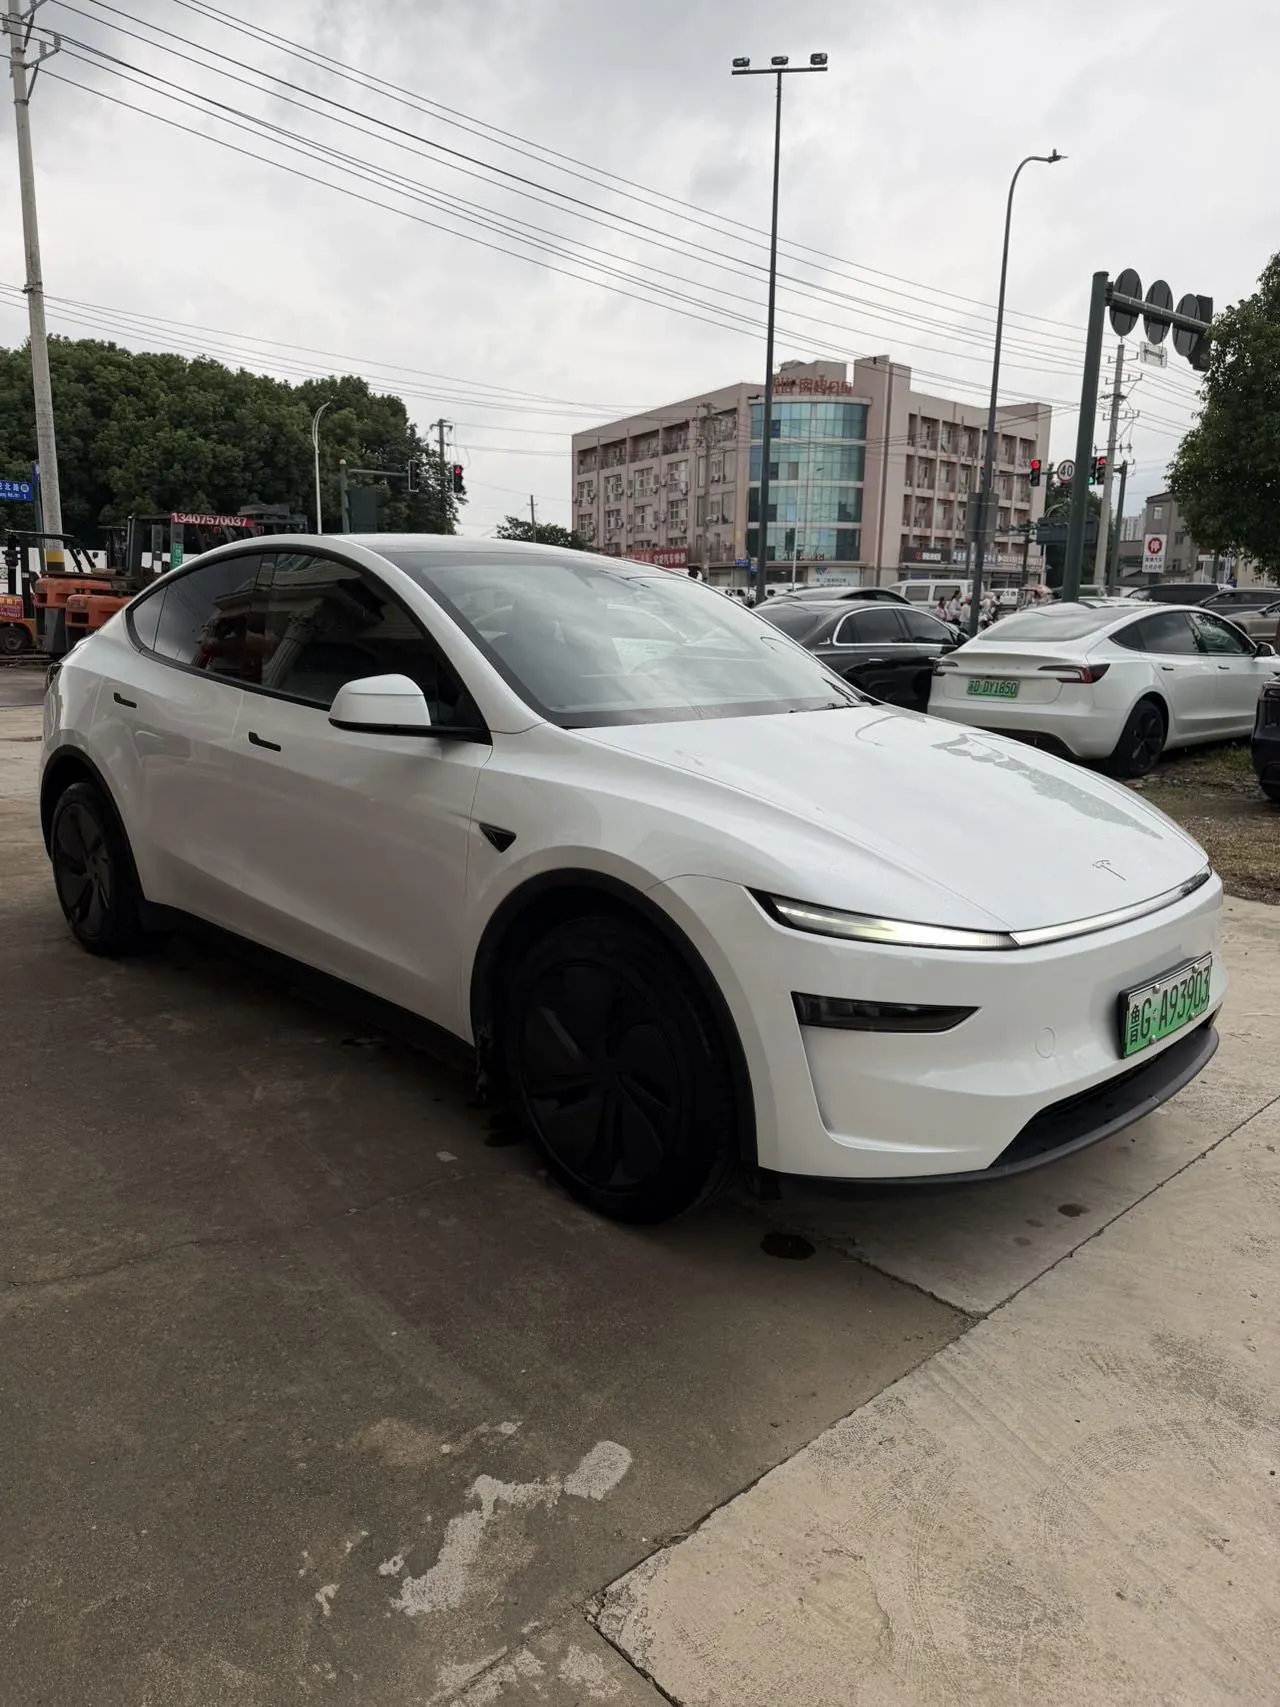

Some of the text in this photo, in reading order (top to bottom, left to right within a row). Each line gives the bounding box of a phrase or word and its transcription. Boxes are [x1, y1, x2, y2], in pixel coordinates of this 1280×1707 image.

[1060, 465, 1073, 477] 40
[172, 512, 248, 527] 13407570037
[1150, 540, 1161, 552] 停
